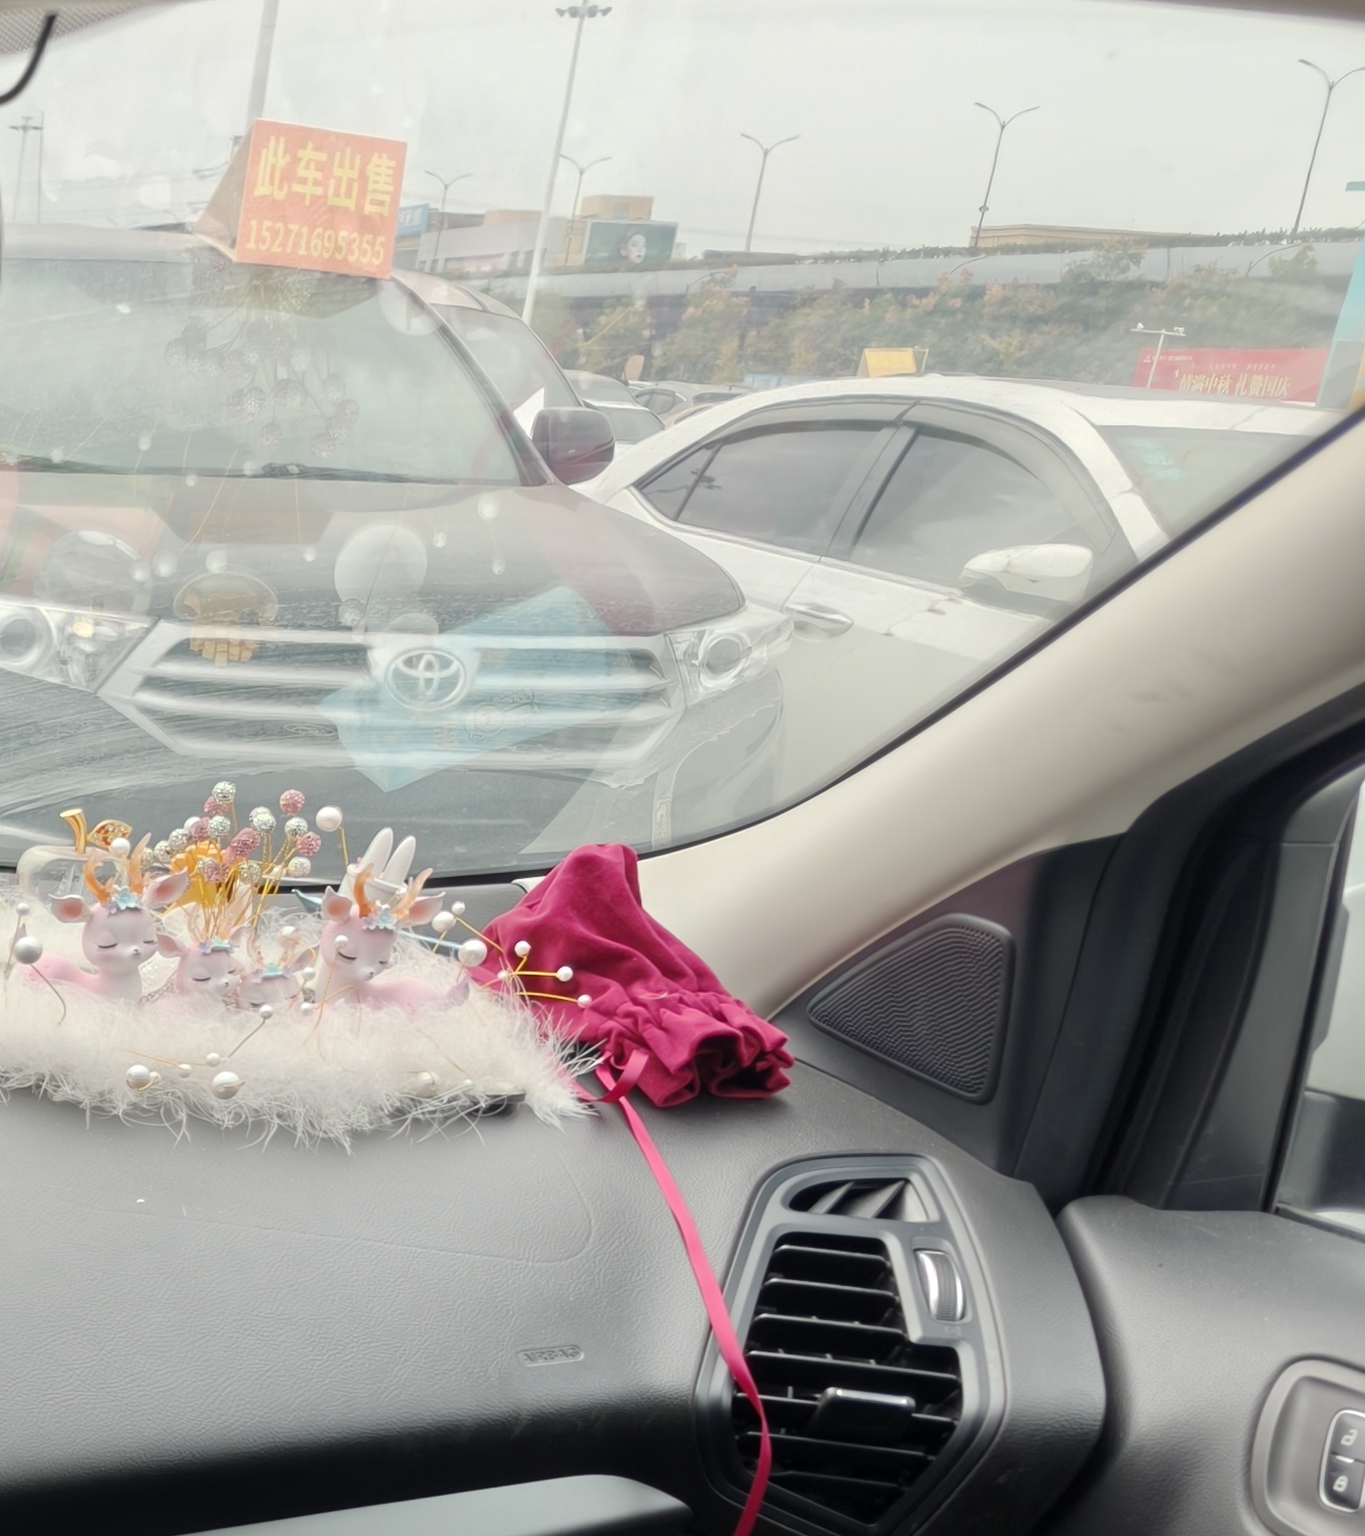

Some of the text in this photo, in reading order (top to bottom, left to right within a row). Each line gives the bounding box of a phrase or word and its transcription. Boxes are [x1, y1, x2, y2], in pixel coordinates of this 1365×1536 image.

[253, 135, 397, 217] 此车出售
[246, 219, 386, 266] 15271695355
